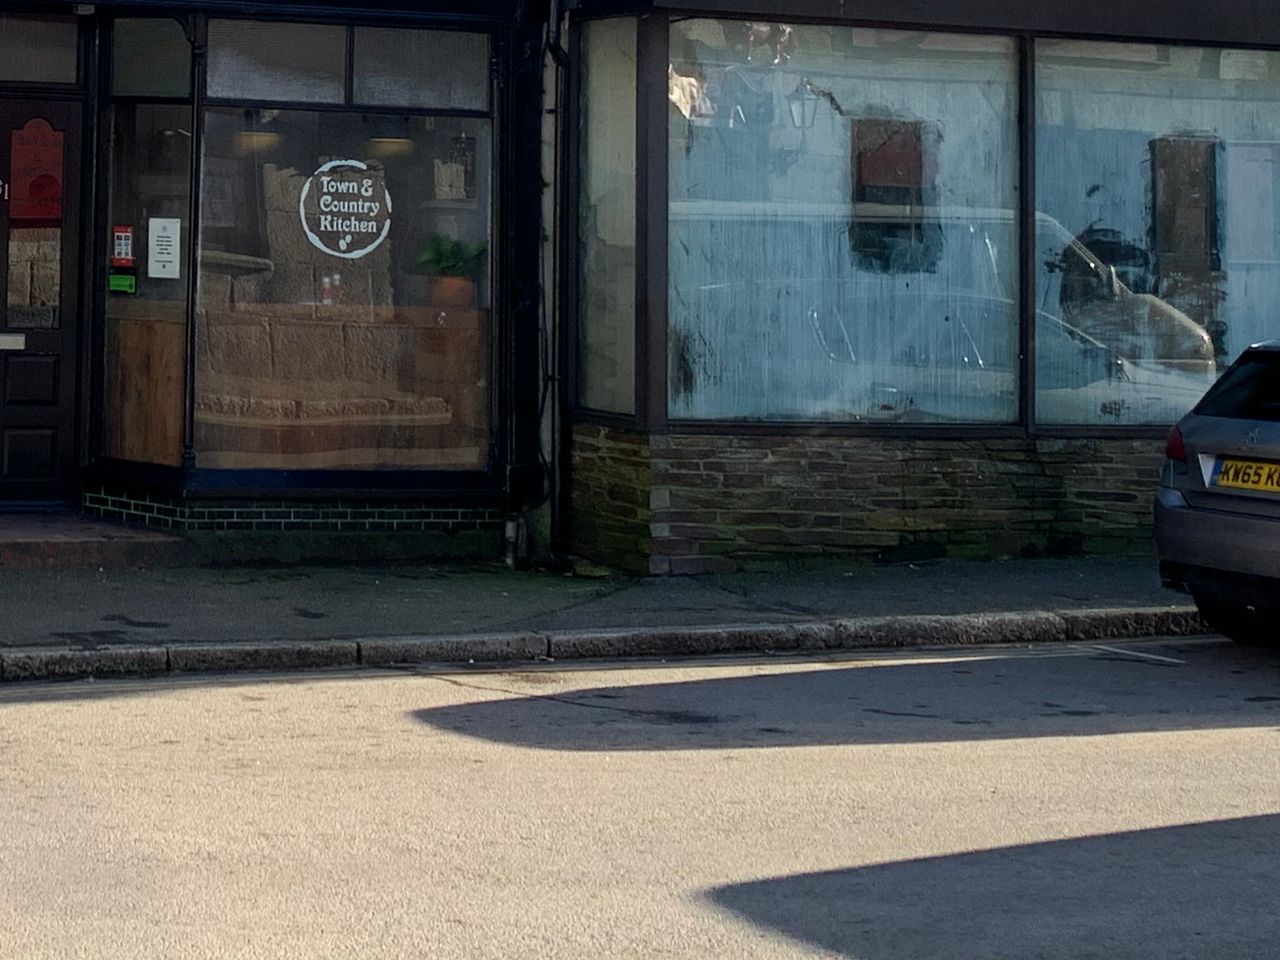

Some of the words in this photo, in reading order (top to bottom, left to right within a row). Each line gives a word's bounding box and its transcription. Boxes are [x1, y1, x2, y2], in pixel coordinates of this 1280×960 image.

[320, 176, 358, 193] Town
[360, 178, 373, 197] &
[320, 195, 380, 217] Country
[320, 214, 377, 232] Kitchen
